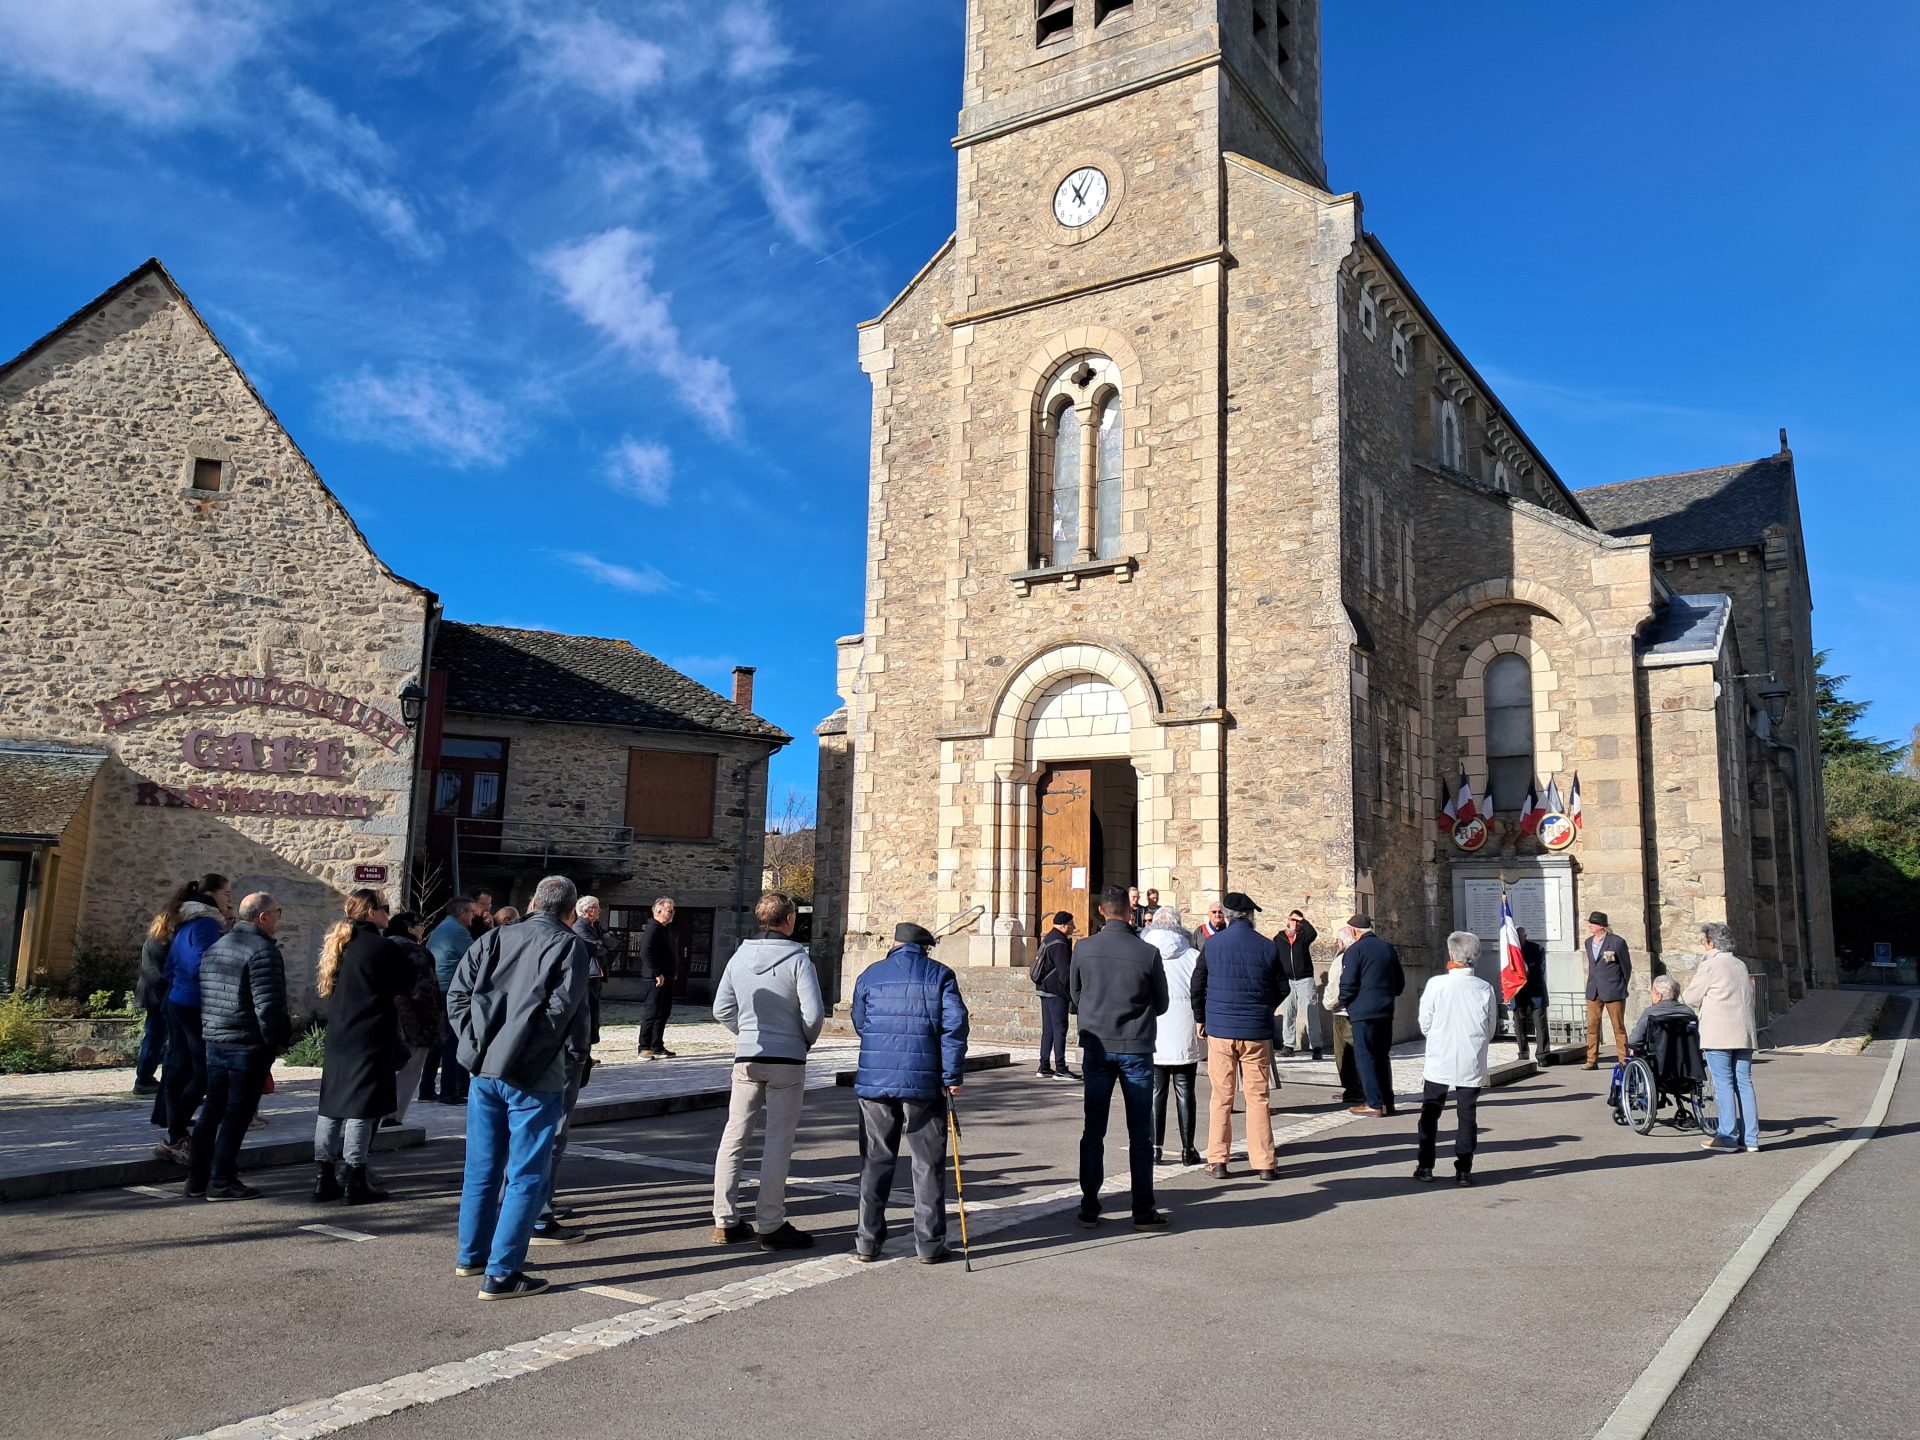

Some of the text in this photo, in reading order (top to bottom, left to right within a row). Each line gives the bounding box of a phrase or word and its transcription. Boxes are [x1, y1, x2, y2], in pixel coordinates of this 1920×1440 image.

[94, 688, 148, 728] LE
[135, 781, 371, 818] RESTAURANT
[1459, 826, 1479, 840] RF
